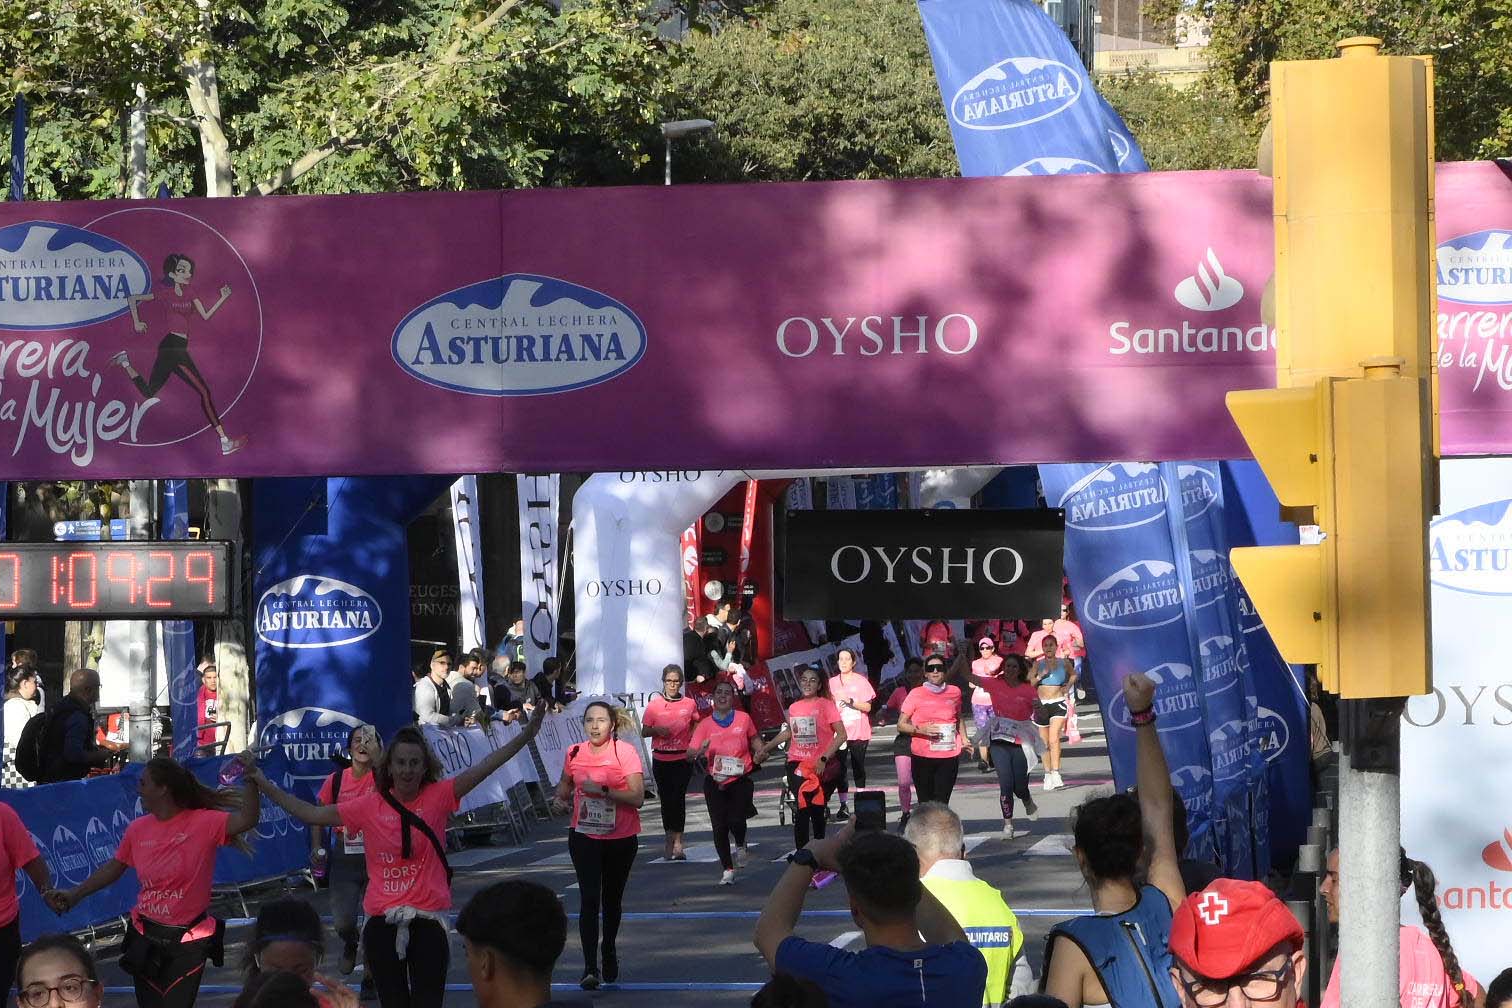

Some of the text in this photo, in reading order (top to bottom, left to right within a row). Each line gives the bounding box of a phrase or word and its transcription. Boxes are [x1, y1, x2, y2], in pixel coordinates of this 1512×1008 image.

[54, 256, 126, 269] LECHERA
[450, 313, 619, 328] CENTRAL LECHERA
[412, 321, 627, 365] ASTURIANA
[776, 313, 978, 357] OYSHO
[12, 376, 161, 467] Mujer
[831, 545, 1024, 586] OYSHO
[586, 578, 662, 599] OYSHO
[273, 599, 369, 609] CENTRAL LECHERA
[261, 605, 374, 632] ASTURIANA
[320, 731, 349, 740] LECH
[383, 866, 418, 879] DORS
